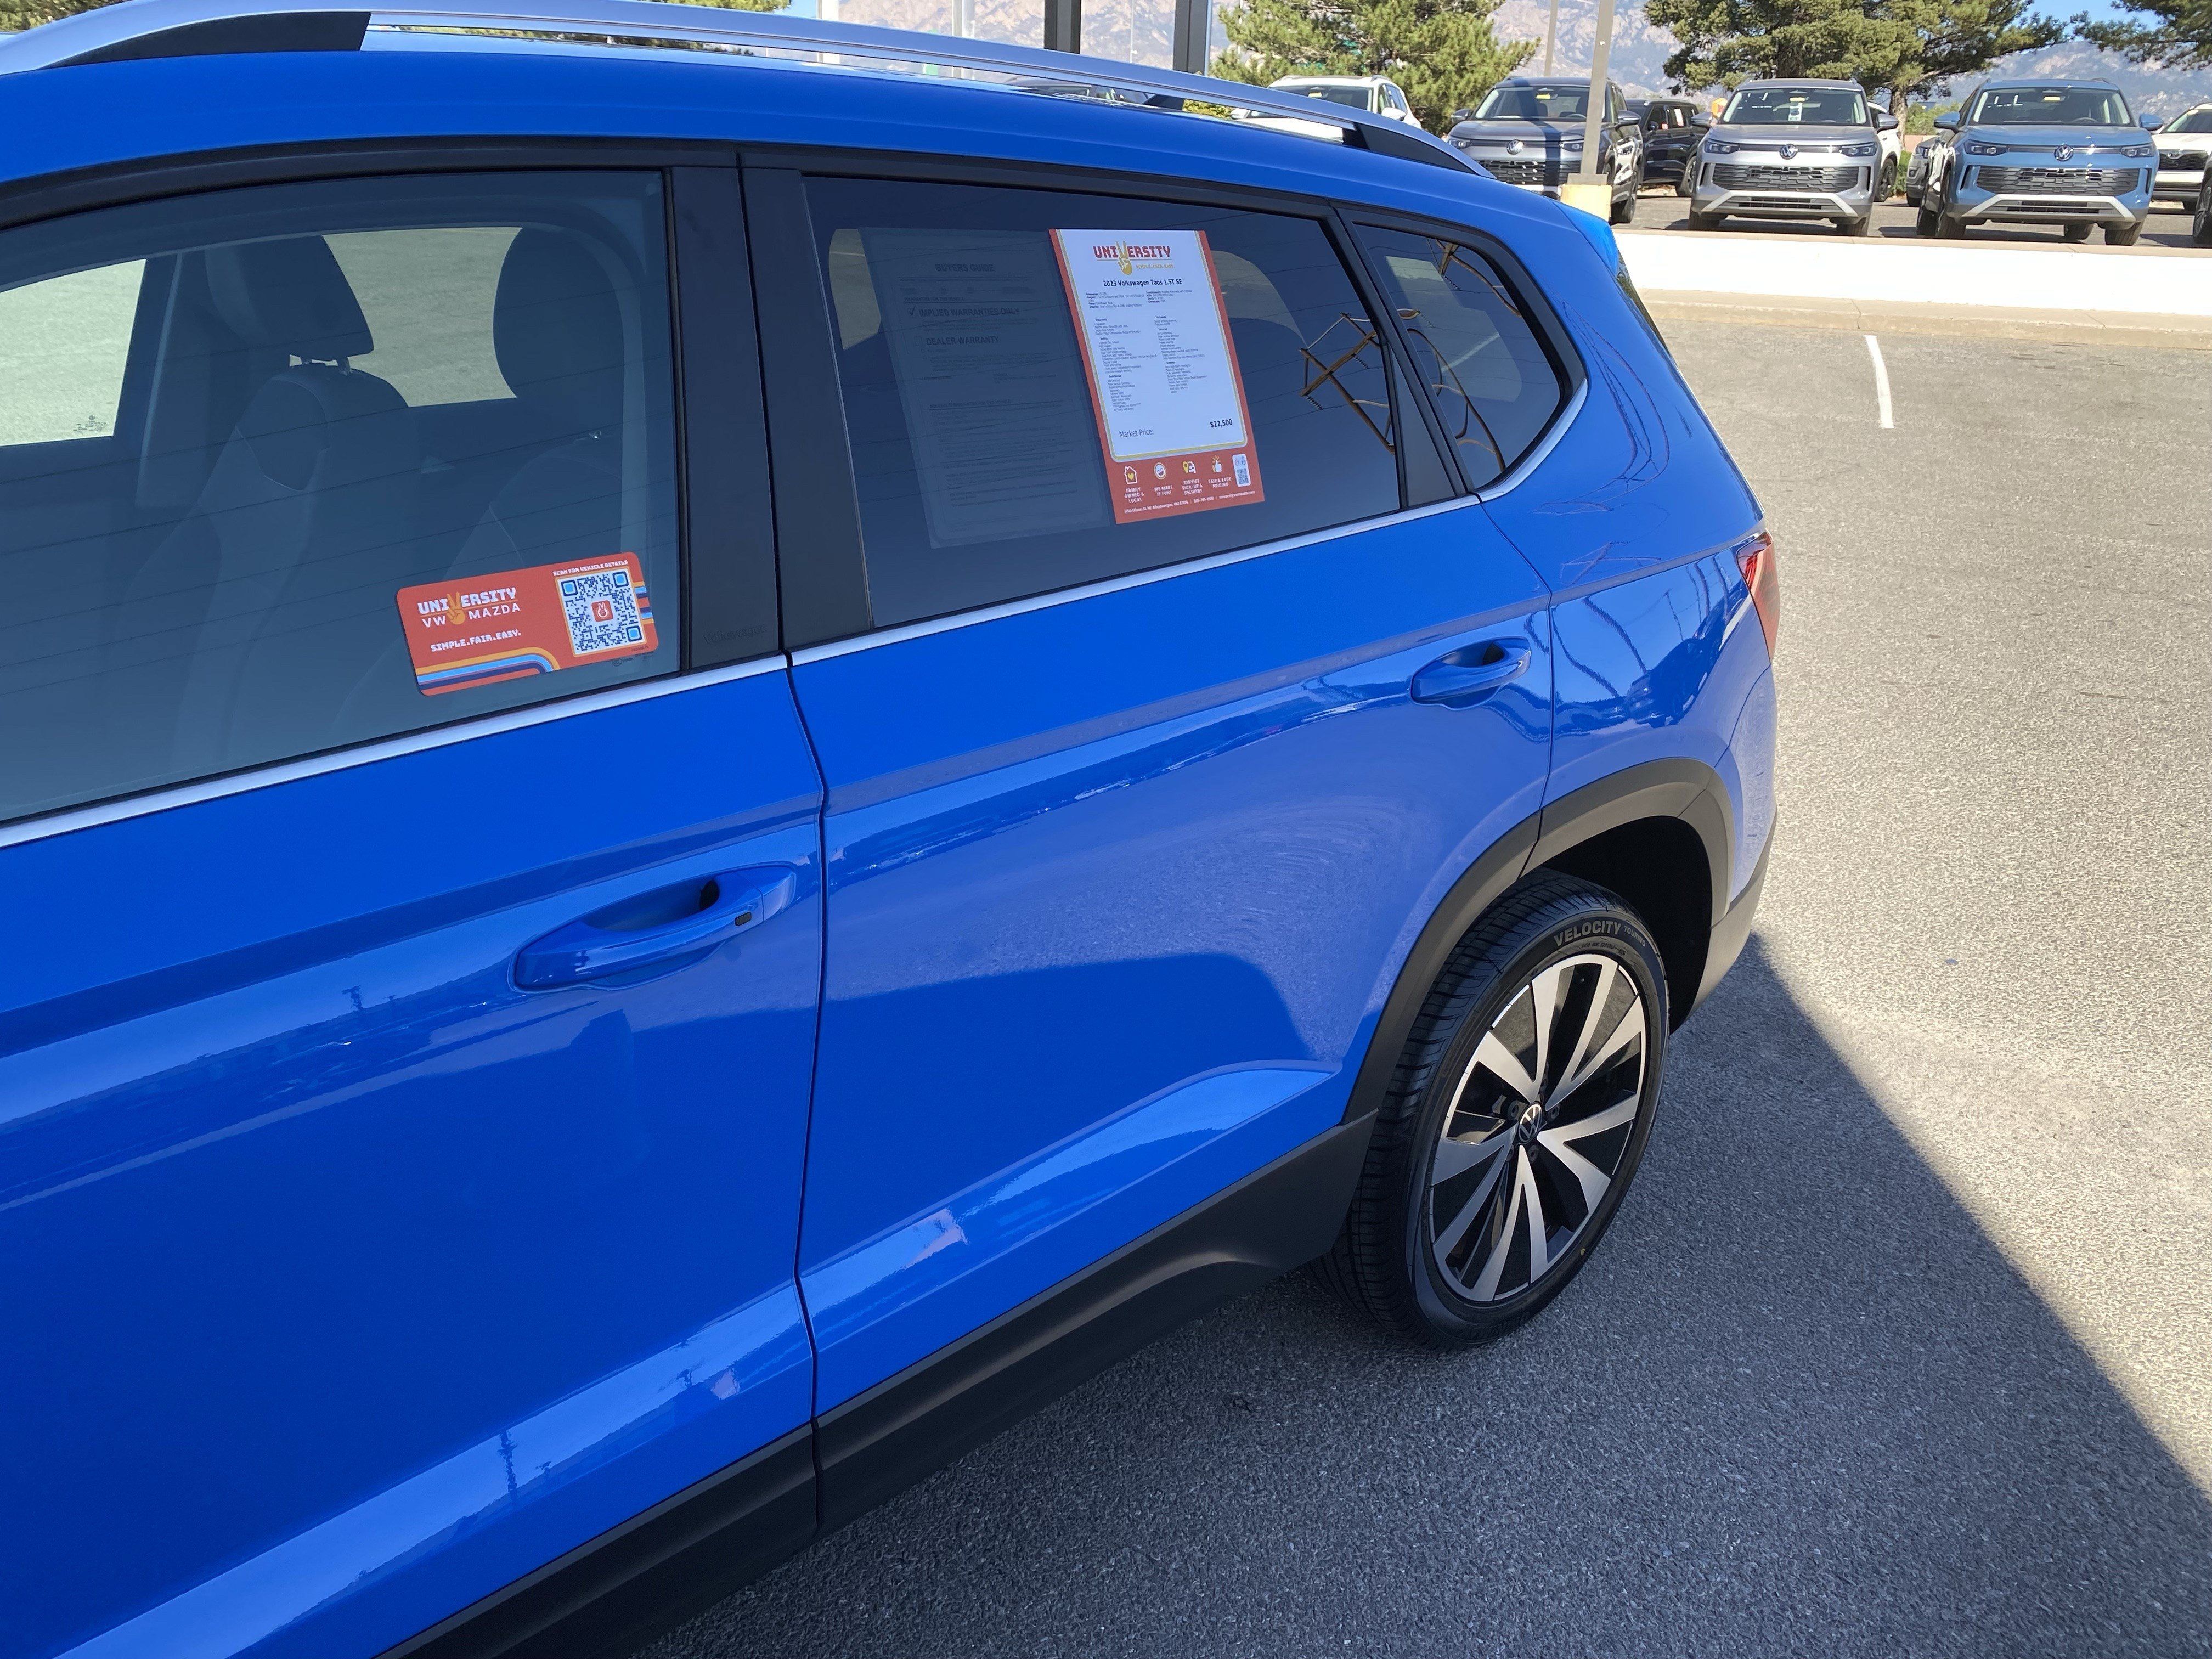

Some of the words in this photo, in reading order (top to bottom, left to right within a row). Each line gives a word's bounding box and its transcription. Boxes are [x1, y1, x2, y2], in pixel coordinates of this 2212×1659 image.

[1093, 241, 1170, 259] UNIVERSITY
[935, 263, 968, 272] BUYERS
[970, 263, 996, 272] GUIDE
[1118, 279, 1150, 287] Volkswagen
[919, 308, 949, 317] IMPLIED
[950, 308, 1000, 317] WARRANTIES
[1000, 307, 1019, 315] ONLY
[926, 337, 957, 345] DEALER
[957, 336, 999, 345] WARRANTY
[1210, 419, 1233, 428] $22,500
[1119, 430, 1138, 438] Market
[1139, 428, 1154, 437] Price:
[580, 563, 604, 572] VEHICLE
[605, 560, 628, 568] DETAILS
[417, 587, 516, 614] UNIVERSITY
[422, 615, 446, 628] VW
[468, 603, 521, 620] MAZDA
[430, 629, 521, 652] SIMPLE.FAIR.EASY.
[1554, 920, 1622, 946] VELOCITY
[1623, 925, 1646, 947] TOURING
[1518, 1103, 1542, 1143] VW
